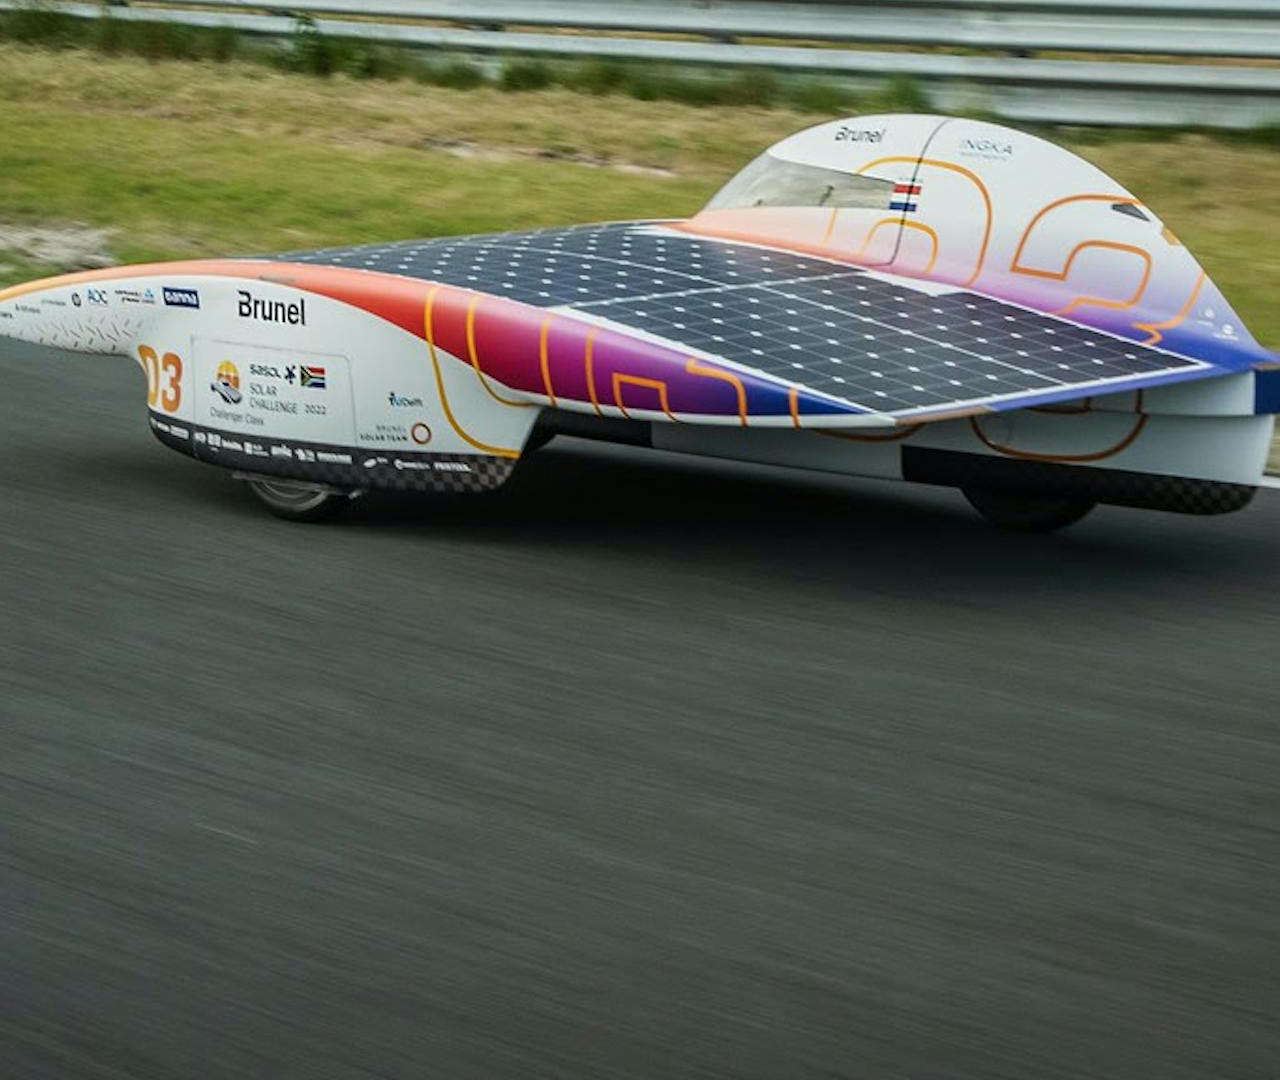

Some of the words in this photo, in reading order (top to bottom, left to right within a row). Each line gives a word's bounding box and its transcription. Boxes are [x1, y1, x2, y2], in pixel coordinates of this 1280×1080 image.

[834, 126, 887, 144] Brunel
[237, 290, 306, 326] Brunel
[249, 382, 278, 397] SOLAR
[249, 397, 298, 415] CHALLENGE
